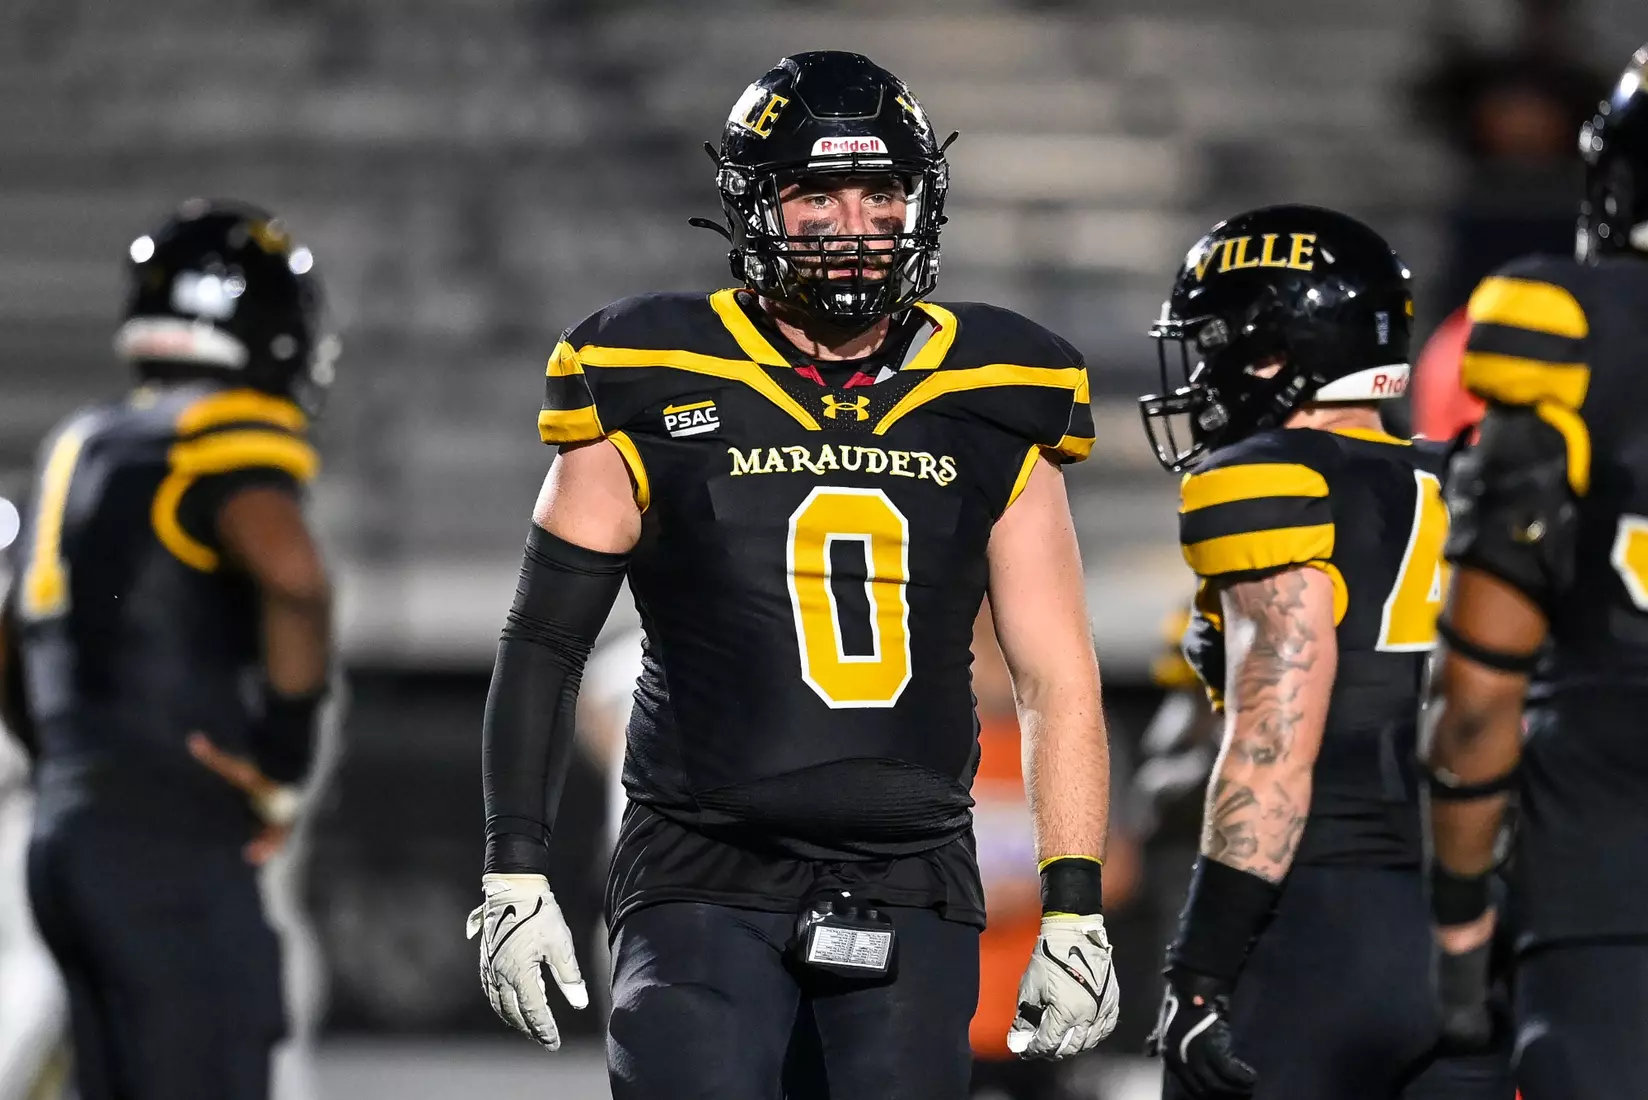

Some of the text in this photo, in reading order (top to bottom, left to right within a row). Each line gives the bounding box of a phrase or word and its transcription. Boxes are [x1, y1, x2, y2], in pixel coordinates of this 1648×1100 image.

[821, 140, 879, 152] Riddell
[1195, 233, 1317, 281] VILLE
[664, 407, 719, 431] PSAC
[728, 444, 957, 487] MARAUDERS
[786, 486, 912, 709] 0
